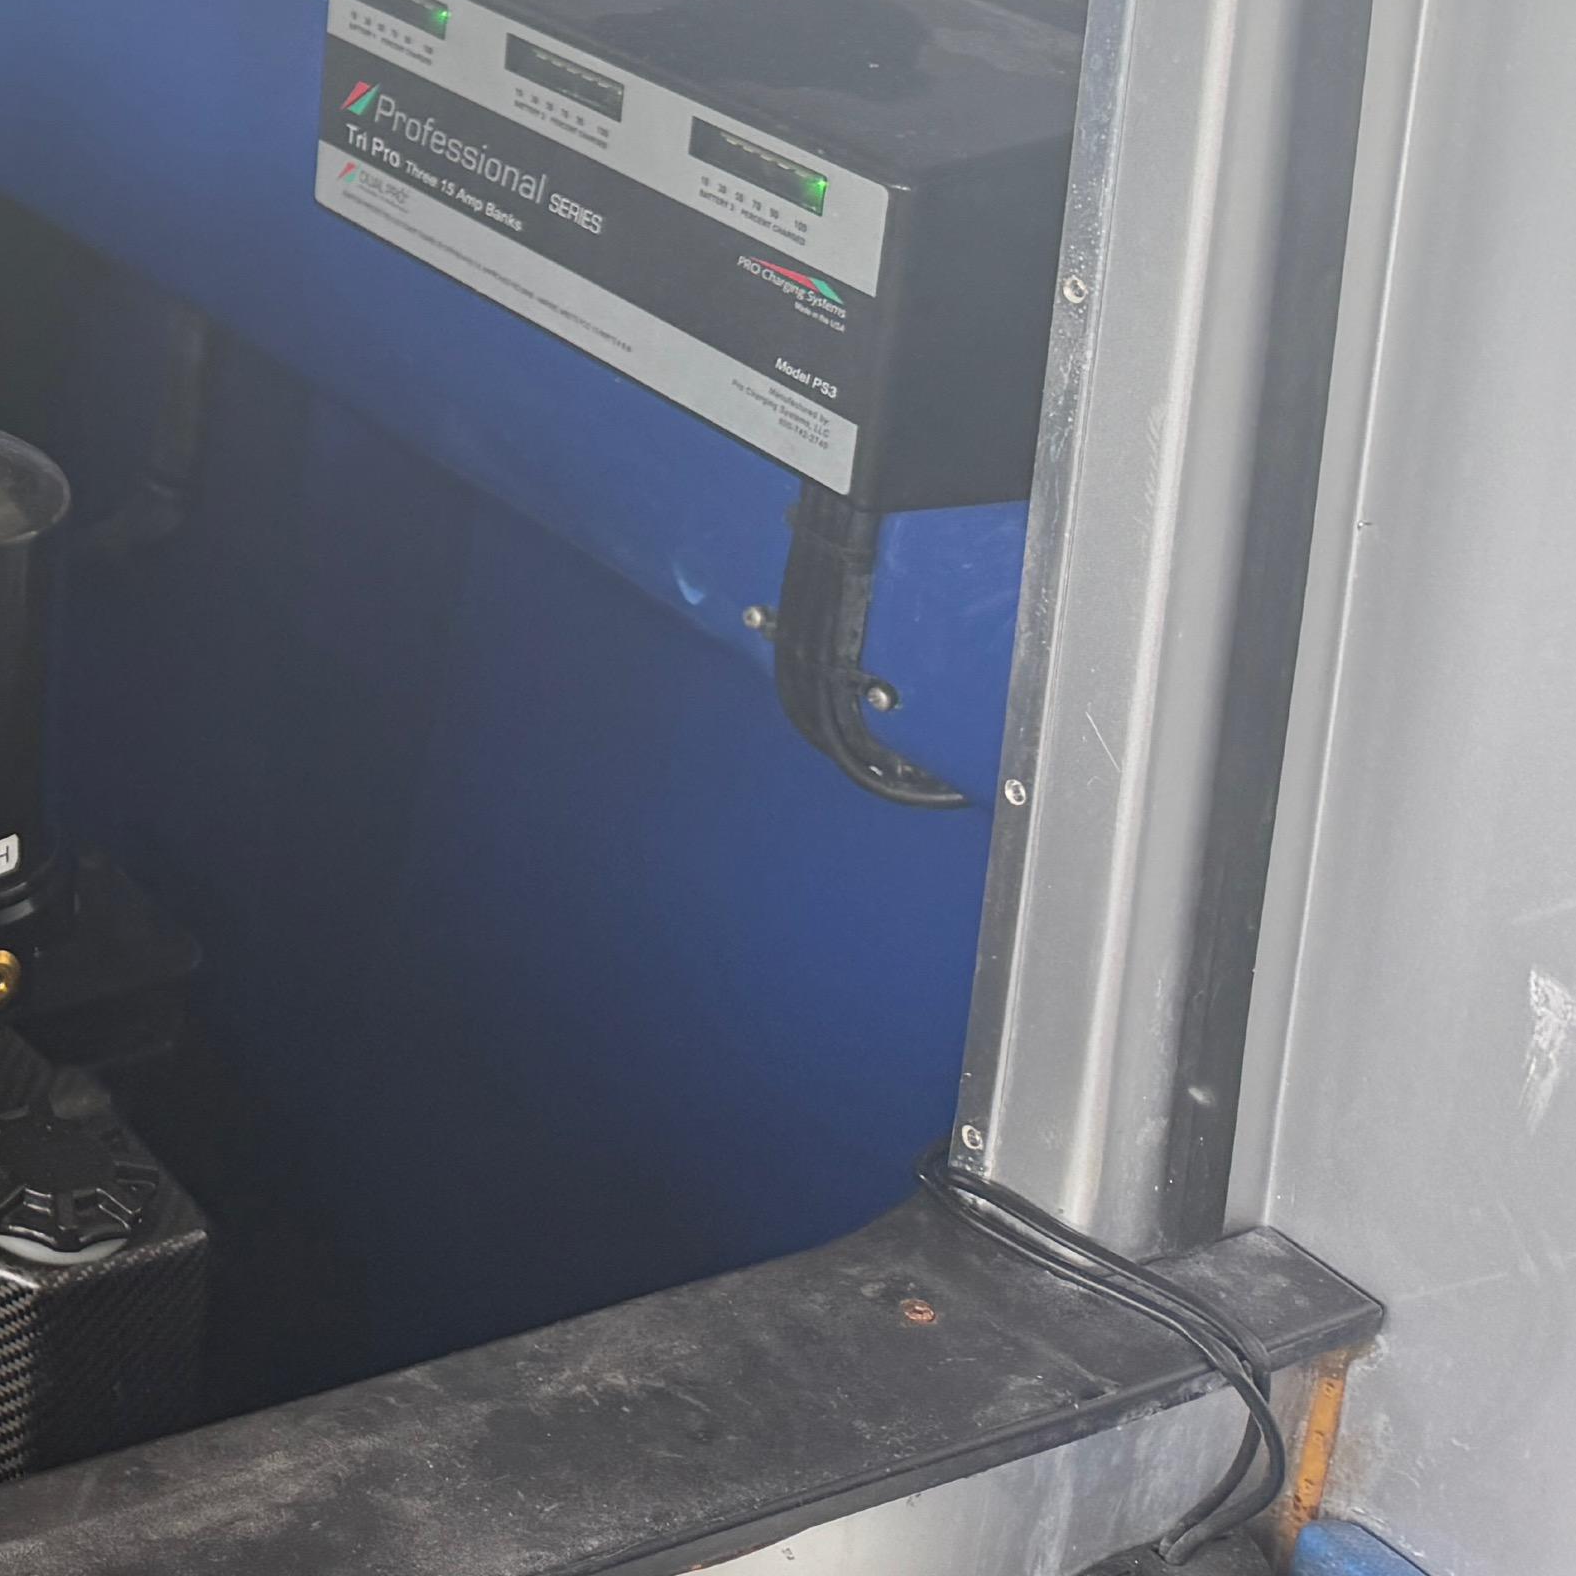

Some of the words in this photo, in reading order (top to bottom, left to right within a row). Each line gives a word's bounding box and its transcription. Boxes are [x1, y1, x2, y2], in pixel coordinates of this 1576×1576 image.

[346, 123, 367, 151] Tri
[371, 137, 401, 168] Pro
[405, 160, 438, 188] Three
[441, 179, 455, 196] 15
[456, 188, 484, 213] Amp
[485, 202, 523, 232] Banks
[375, 94, 547, 204] Professional
[548, 193, 603, 234] SERIES
[737, 256, 761, 274] PRO
[762, 269, 805, 300] Charging
[806, 290, 847, 319] Systems
[775, 357, 810, 385] Model
[812, 376, 838, 399] PS3
[813, 424, 830, 438] LLC
